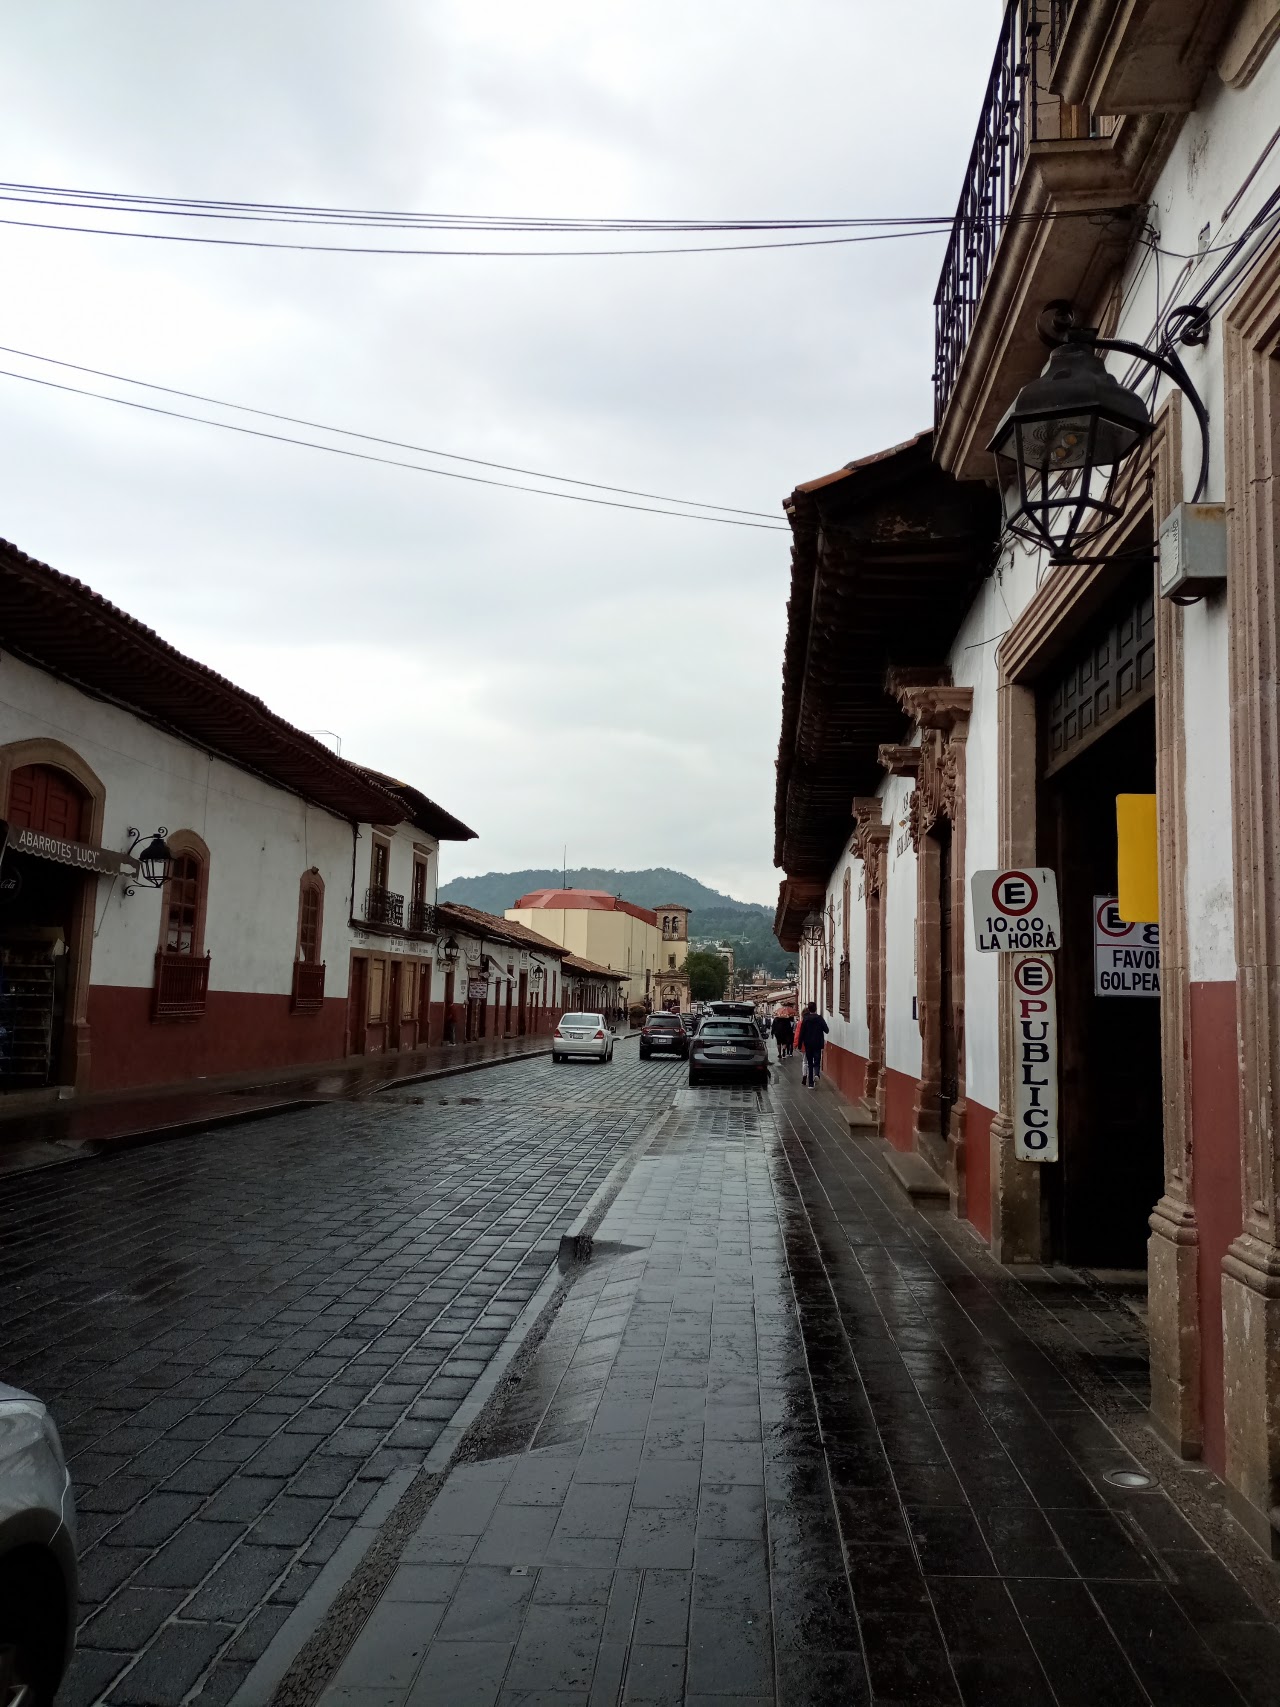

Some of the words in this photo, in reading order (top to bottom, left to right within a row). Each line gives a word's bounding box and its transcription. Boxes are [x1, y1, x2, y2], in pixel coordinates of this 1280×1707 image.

[19, 830, 72, 859] ABARROTES
[1004, 883, 1026, 905] E
[985, 917, 1044, 933] 10.00
[1106, 907, 1127, 929] E
[979, 932, 1002, 950] LA
[1007, 931, 1057, 949] HORA
[1022, 966, 1044, 986] E
[1019, 999, 1050, 1150] PUBLICO
